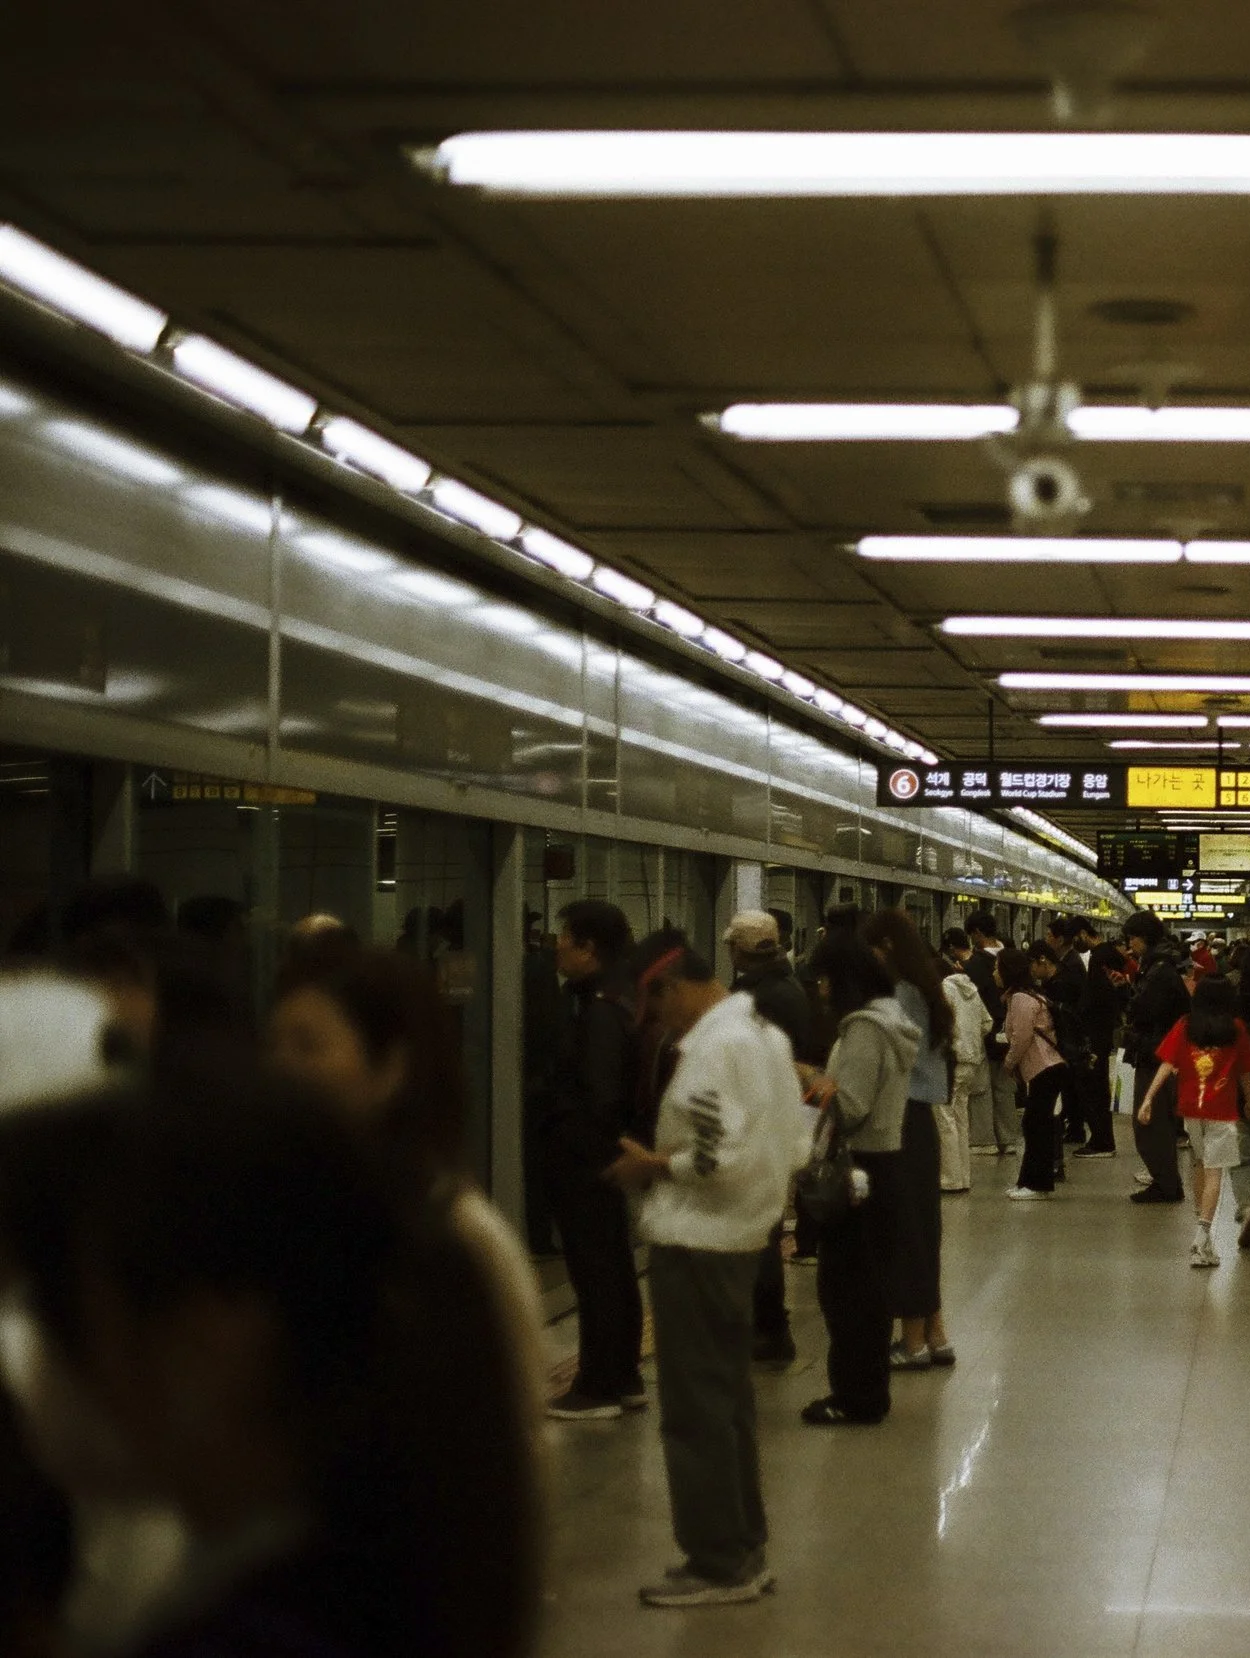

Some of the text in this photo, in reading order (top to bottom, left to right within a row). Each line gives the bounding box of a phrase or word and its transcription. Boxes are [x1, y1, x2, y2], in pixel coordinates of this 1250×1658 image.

[897, 775, 911, 793] 6
[926, 772, 1108, 788] 석계 공덕 월드컵경기장 응암
[1136, 772, 1205, 791] 나가는 곳
[1242, 775, 1249, 785] 2
[1000, 789, 1022, 798] World
[1023, 789, 1037, 799] Cup
[1038, 789, 1067, 798] Stadium
[1225, 793, 1231, 803] 5
[1242, 793, 1249, 803] 6
